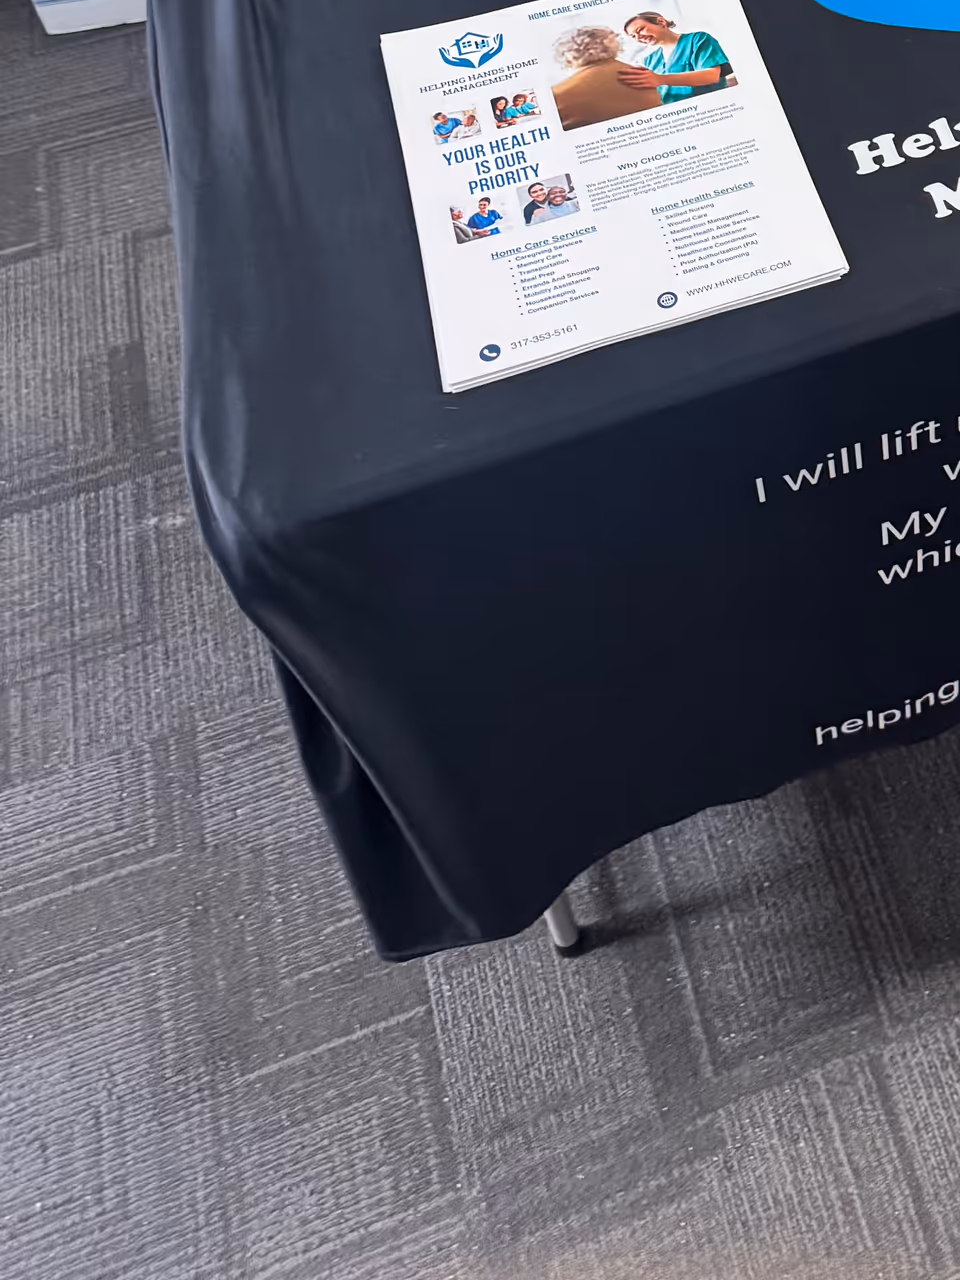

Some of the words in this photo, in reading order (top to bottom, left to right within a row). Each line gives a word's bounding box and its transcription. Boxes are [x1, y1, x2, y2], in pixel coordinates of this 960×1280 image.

[528, 10, 551, 21] HOME
[551, 5, 572, 15] CARE
[419, 77, 466, 94] HELPING
[468, 67, 505, 82] HANDS
[506, 58, 538, 72] HOME
[442, 71, 519, 96] MANAGEMENT
[607, 122, 634, 134] About
[636, 117, 653, 126] Our
[655, 105, 698, 120] Company
[442, 144, 486, 166] YOUR
[489, 126, 550, 155] HEALTH
[617, 162, 638, 171] Why
[640, 148, 683, 165] CHOOSE
[468, 163, 539, 195] PRIORITY
[475, 160, 491, 176] IS
[494, 150, 527, 170] OUR
[651, 202, 679, 213] Home
[681, 193, 712, 205] Health
[713, 181, 754, 196] Services
[491, 247, 522, 259] Home
[524, 239, 549, 250] Care
[552, 226, 597, 242] Services
[686, 260, 792, 297] WWW.HHWECARE.COM
[510, 324, 578, 350] 317-353-5161
[756, 478, 765, 502] I
[783, 443, 863, 491] will
[882, 421, 942, 460] lift
[882, 507, 947, 546] My
